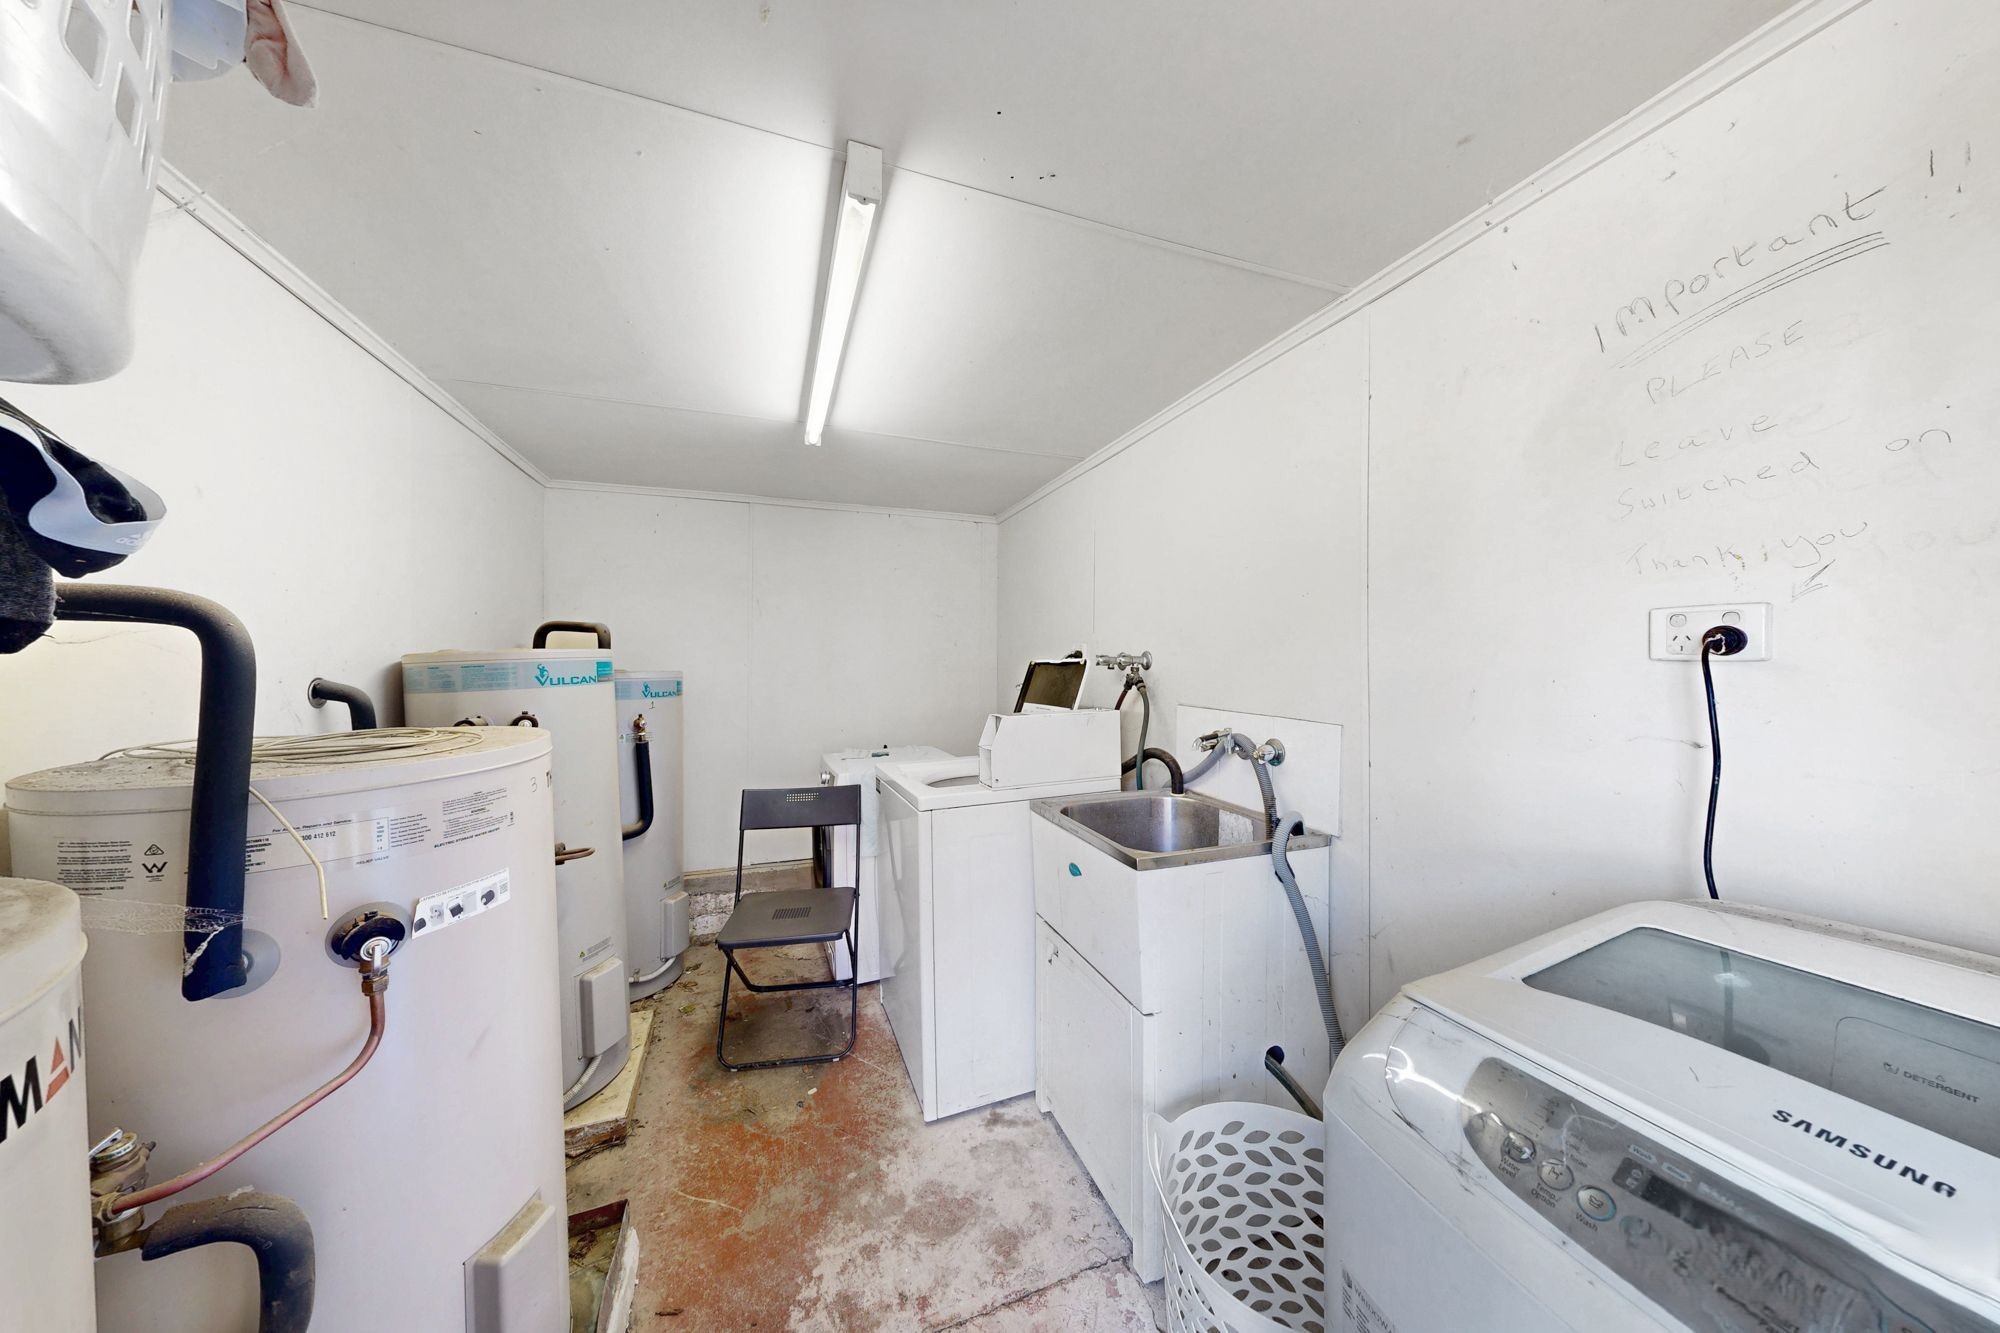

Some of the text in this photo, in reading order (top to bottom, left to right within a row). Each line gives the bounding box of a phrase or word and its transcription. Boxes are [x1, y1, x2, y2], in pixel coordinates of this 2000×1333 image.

[1885, 428, 1952, 453] on
[534, 674, 597, 688] VULCAN
[1903, 1071, 1981, 1103] DETERGENT
[1772, 1109, 1957, 1198] SAMSUNG
[1531, 1187, 1557, 1208] Option
[1575, 1211, 1599, 1232] Wash
